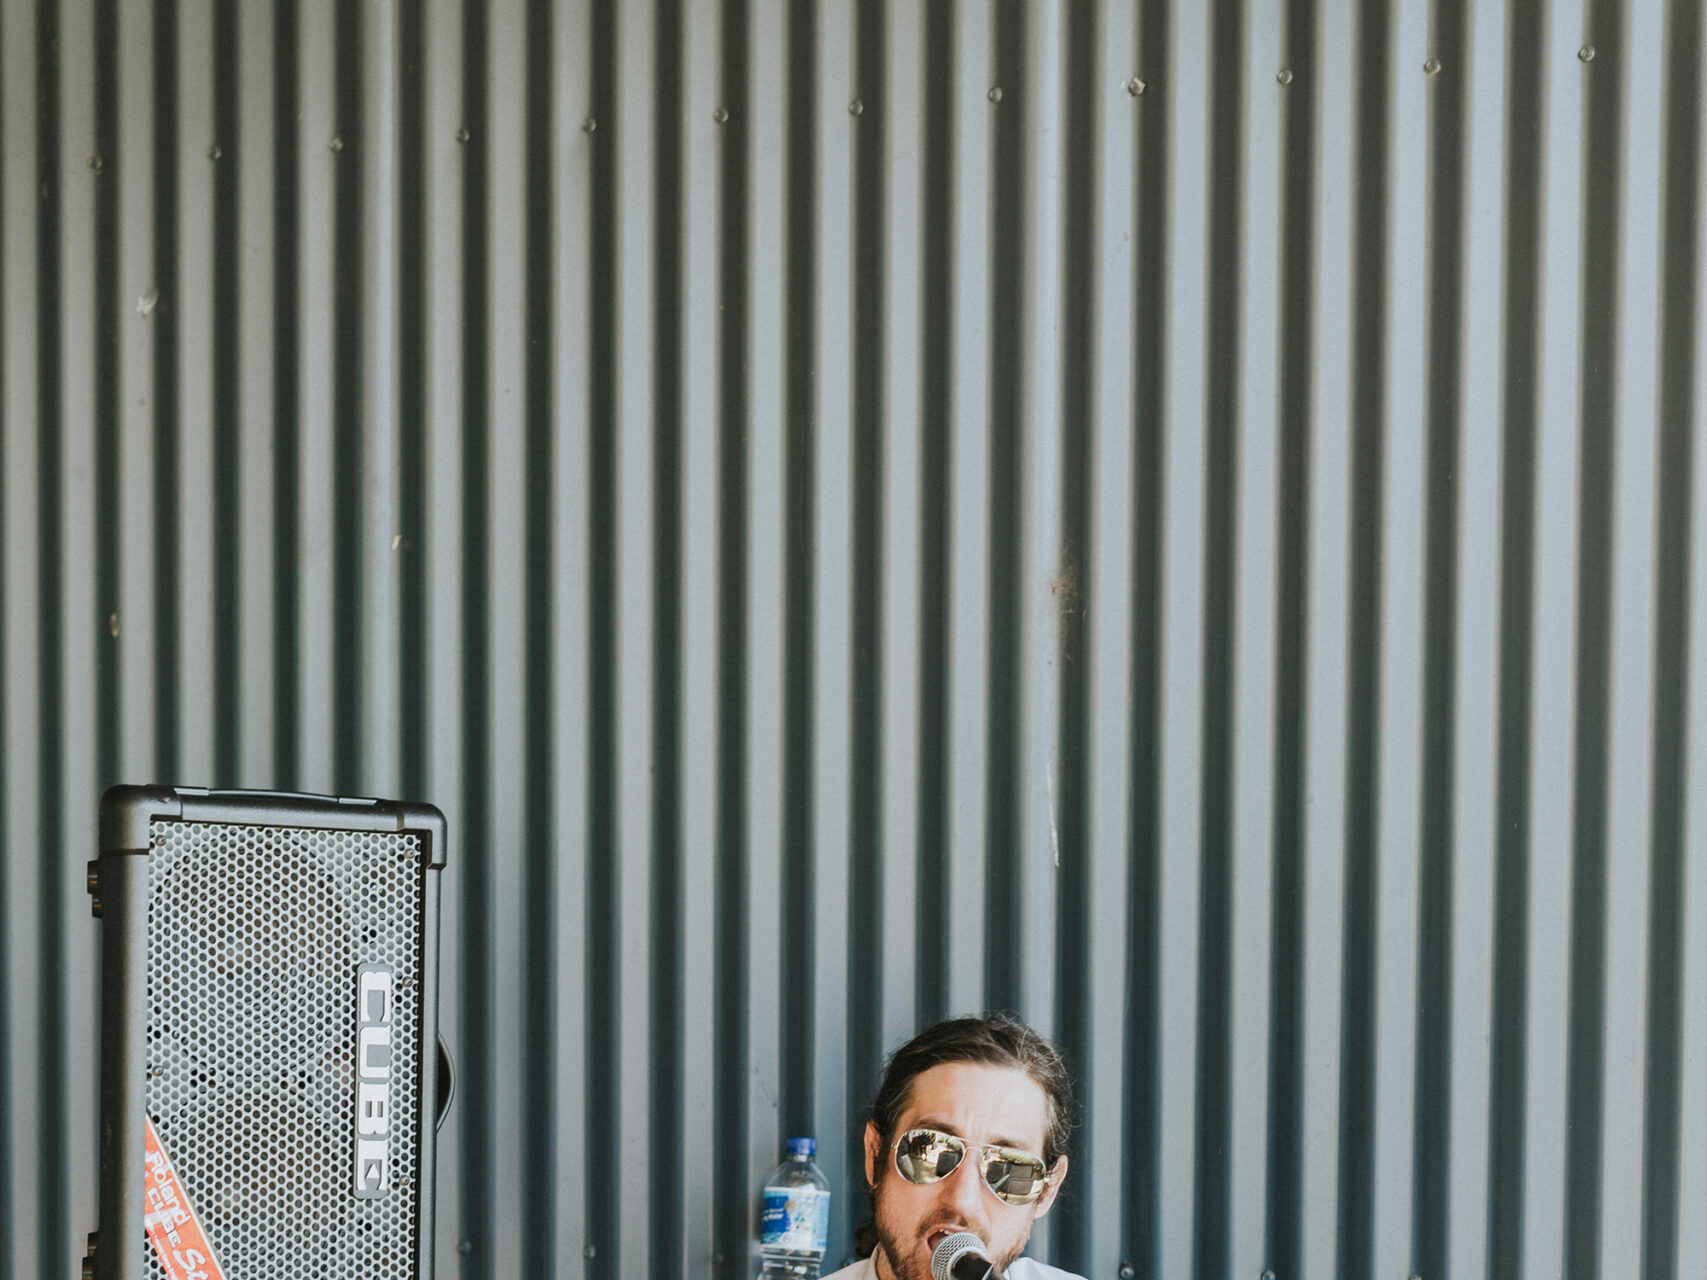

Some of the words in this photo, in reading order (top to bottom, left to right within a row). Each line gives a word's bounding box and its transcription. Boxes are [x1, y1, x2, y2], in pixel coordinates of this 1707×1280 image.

[356, 971, 391, 1191] CUBE
[146, 1151, 191, 1227] Roland
[148, 1186, 182, 1248] CUBE
